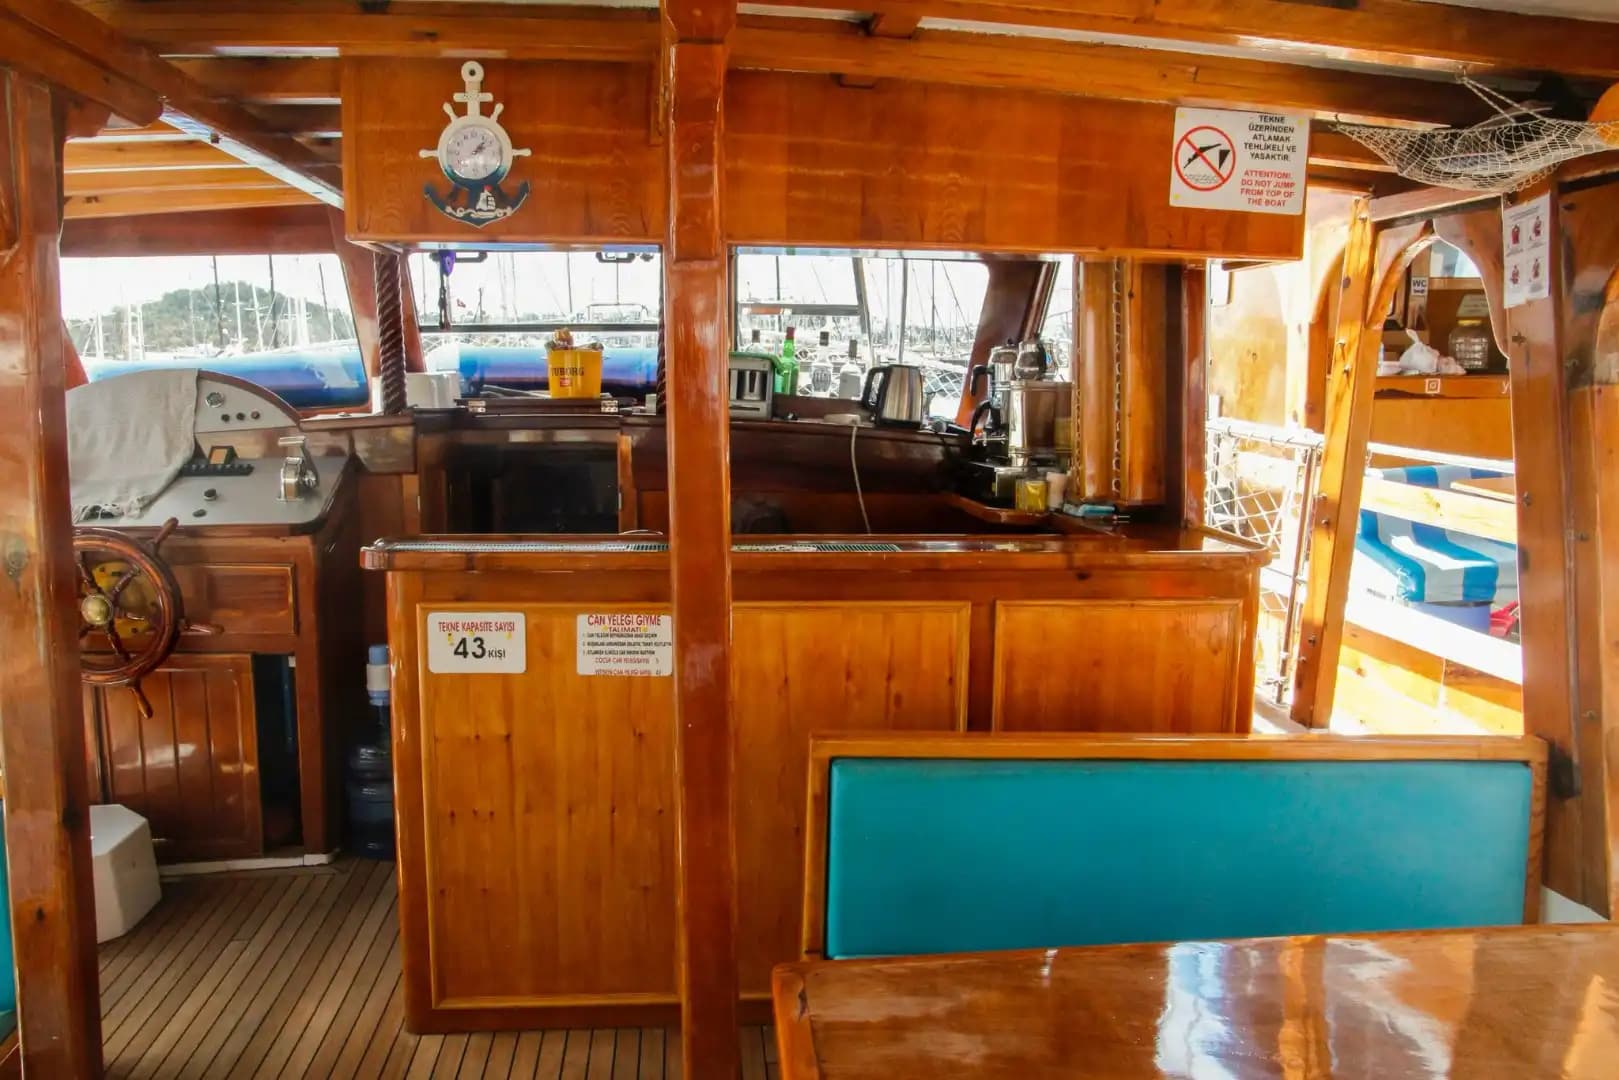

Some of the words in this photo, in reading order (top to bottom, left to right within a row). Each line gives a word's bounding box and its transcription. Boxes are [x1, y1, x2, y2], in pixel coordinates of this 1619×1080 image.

[1259, 115, 1286, 124] TEKNE
[1248, 123, 1295, 133] ÜZERİNDEN
[1252, 134, 1291, 142] ATLAMAK
[1286, 145, 1296, 153] VE
[1241, 178, 1253, 186] DO
[1273, 181, 1296, 189] JUMP
[1240, 188, 1264, 196] FROM
[1266, 189, 1282, 197] TOP
[1247, 198, 1263, 206] THE
[1264, 199, 1286, 207] BOAT
[1412, 279, 1427, 288] WC
[587, 615, 606, 626] CAN
[438, 621, 460, 632] TEKNE
[453, 636, 487, 659] 43
